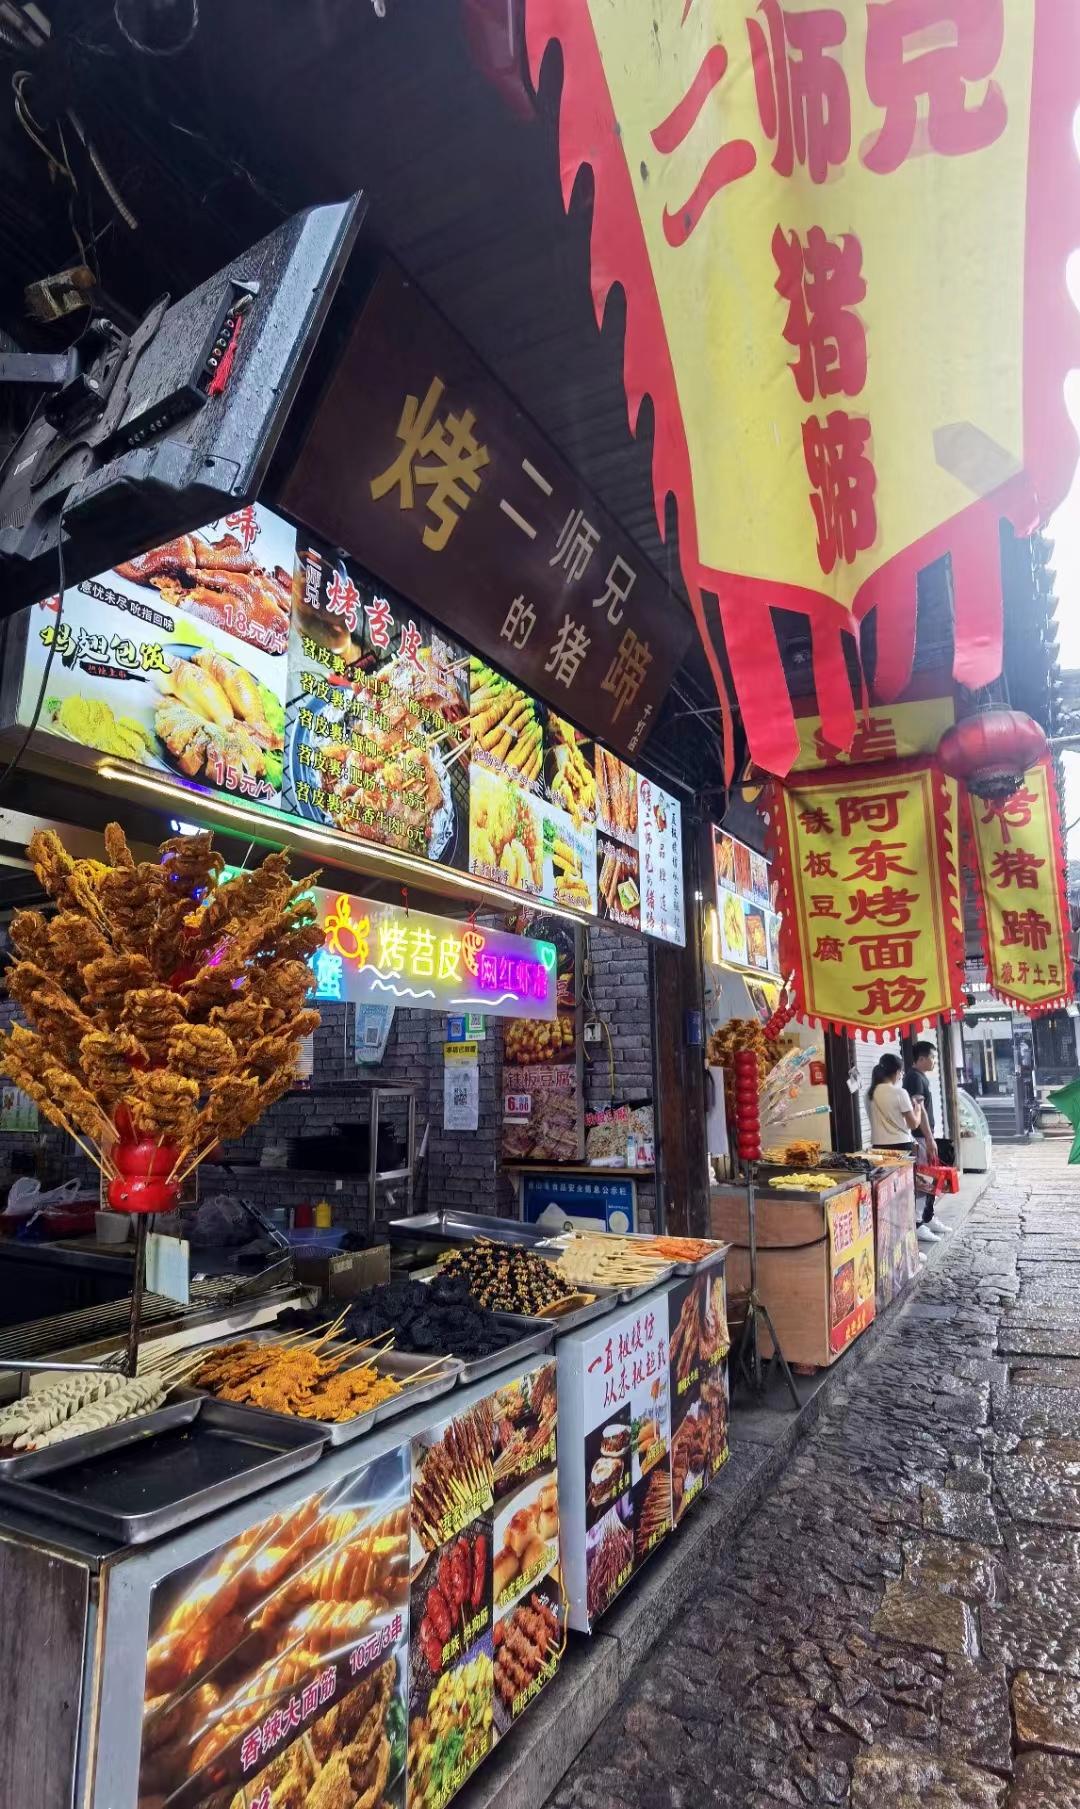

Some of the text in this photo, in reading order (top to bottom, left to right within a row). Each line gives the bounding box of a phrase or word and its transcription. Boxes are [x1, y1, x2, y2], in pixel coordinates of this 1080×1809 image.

[650, 0, 1008, 247] 二师兄
[369, 376, 490, 551] 烤
[772, 223, 878, 574] 猪蹄
[500, 458, 637, 625] 二师兄
[39, 624, 172, 674] 鸡翅包饭
[224, 604, 284, 654] 18元/片
[326, 570, 425, 673] 烤苕皮
[500, 593, 653, 724] 的猪蹄
[215, 761, 277, 800] 15元/个
[799, 808, 845, 962] 铁板豆腐
[835, 791, 928, 1016] 阿东烤面筋
[980, 788, 1052, 951] 烤猪蹄
[378, 920, 464, 982] 烤苕皮
[240, 1614, 403, 1772] 香辣大面筋 10元/3串
